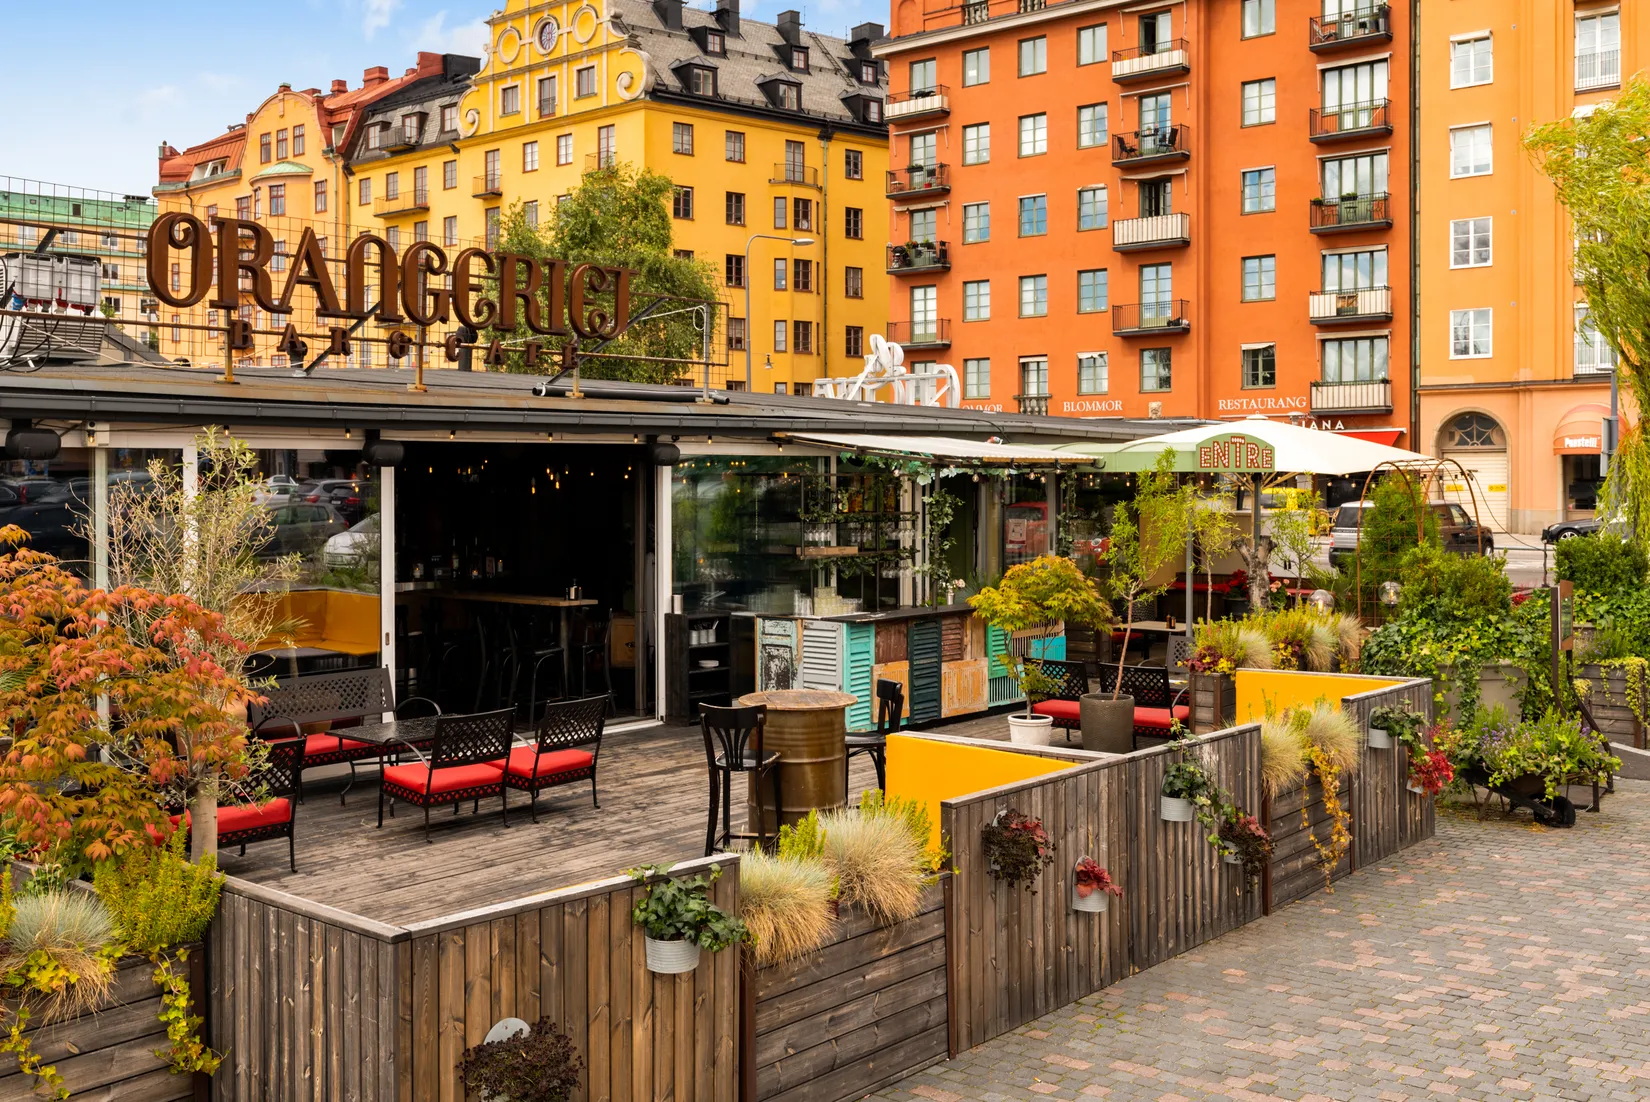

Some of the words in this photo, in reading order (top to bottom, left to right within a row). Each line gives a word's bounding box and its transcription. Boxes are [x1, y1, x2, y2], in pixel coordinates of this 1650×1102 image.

[229, 318, 353, 357] BAR
[1063, 400, 1123, 412] BLOMMOR
[1218, 396, 1307, 411] RESTAURANG
[1200, 435, 1273, 468] ENTRÉ
